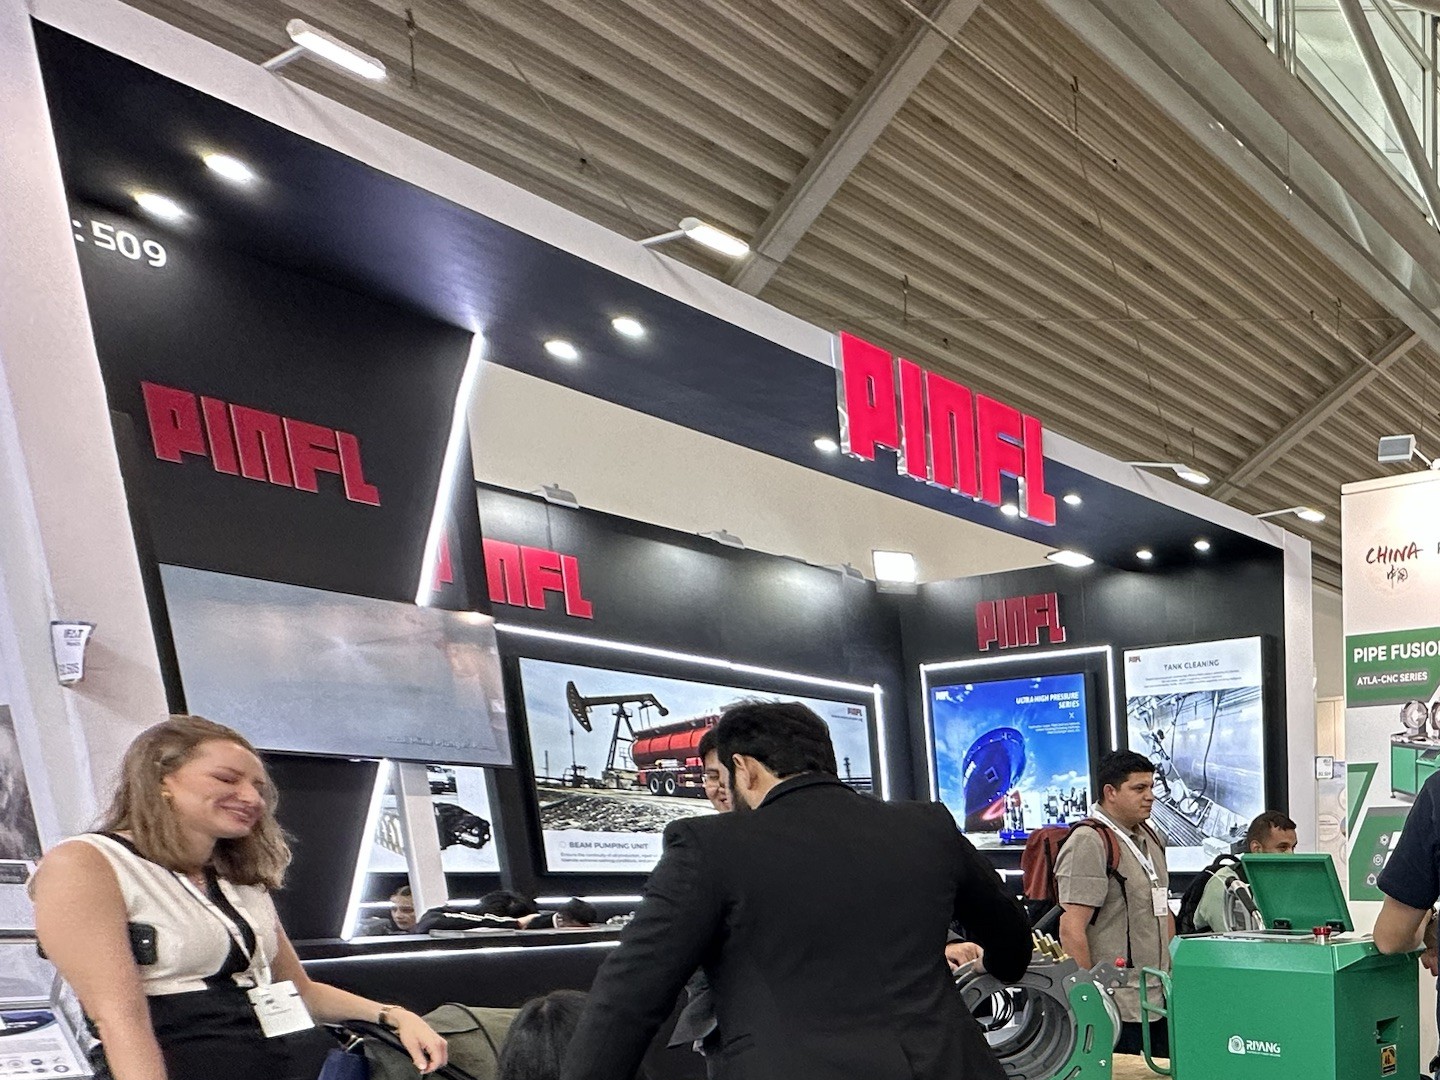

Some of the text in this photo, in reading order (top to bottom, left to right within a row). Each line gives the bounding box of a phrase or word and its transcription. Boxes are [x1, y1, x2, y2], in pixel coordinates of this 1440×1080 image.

[838, 330, 1056, 527] PINFL
[141, 380, 381, 507] PINFL
[1365, 541, 1424, 565] CHINA
[974, 591, 1067, 652] PINFL
[1353, 645, 1388, 663] PIPE
[1163, 659, 1220, 671] TANK CLEANING
[1356, 671, 1428, 686] ATLA-CNC SERIES
[1049, 691, 1080, 702] PRESSURE
[1058, 700, 1080, 709] SERIES
[1246, 1039, 1281, 1054] RIYANG
